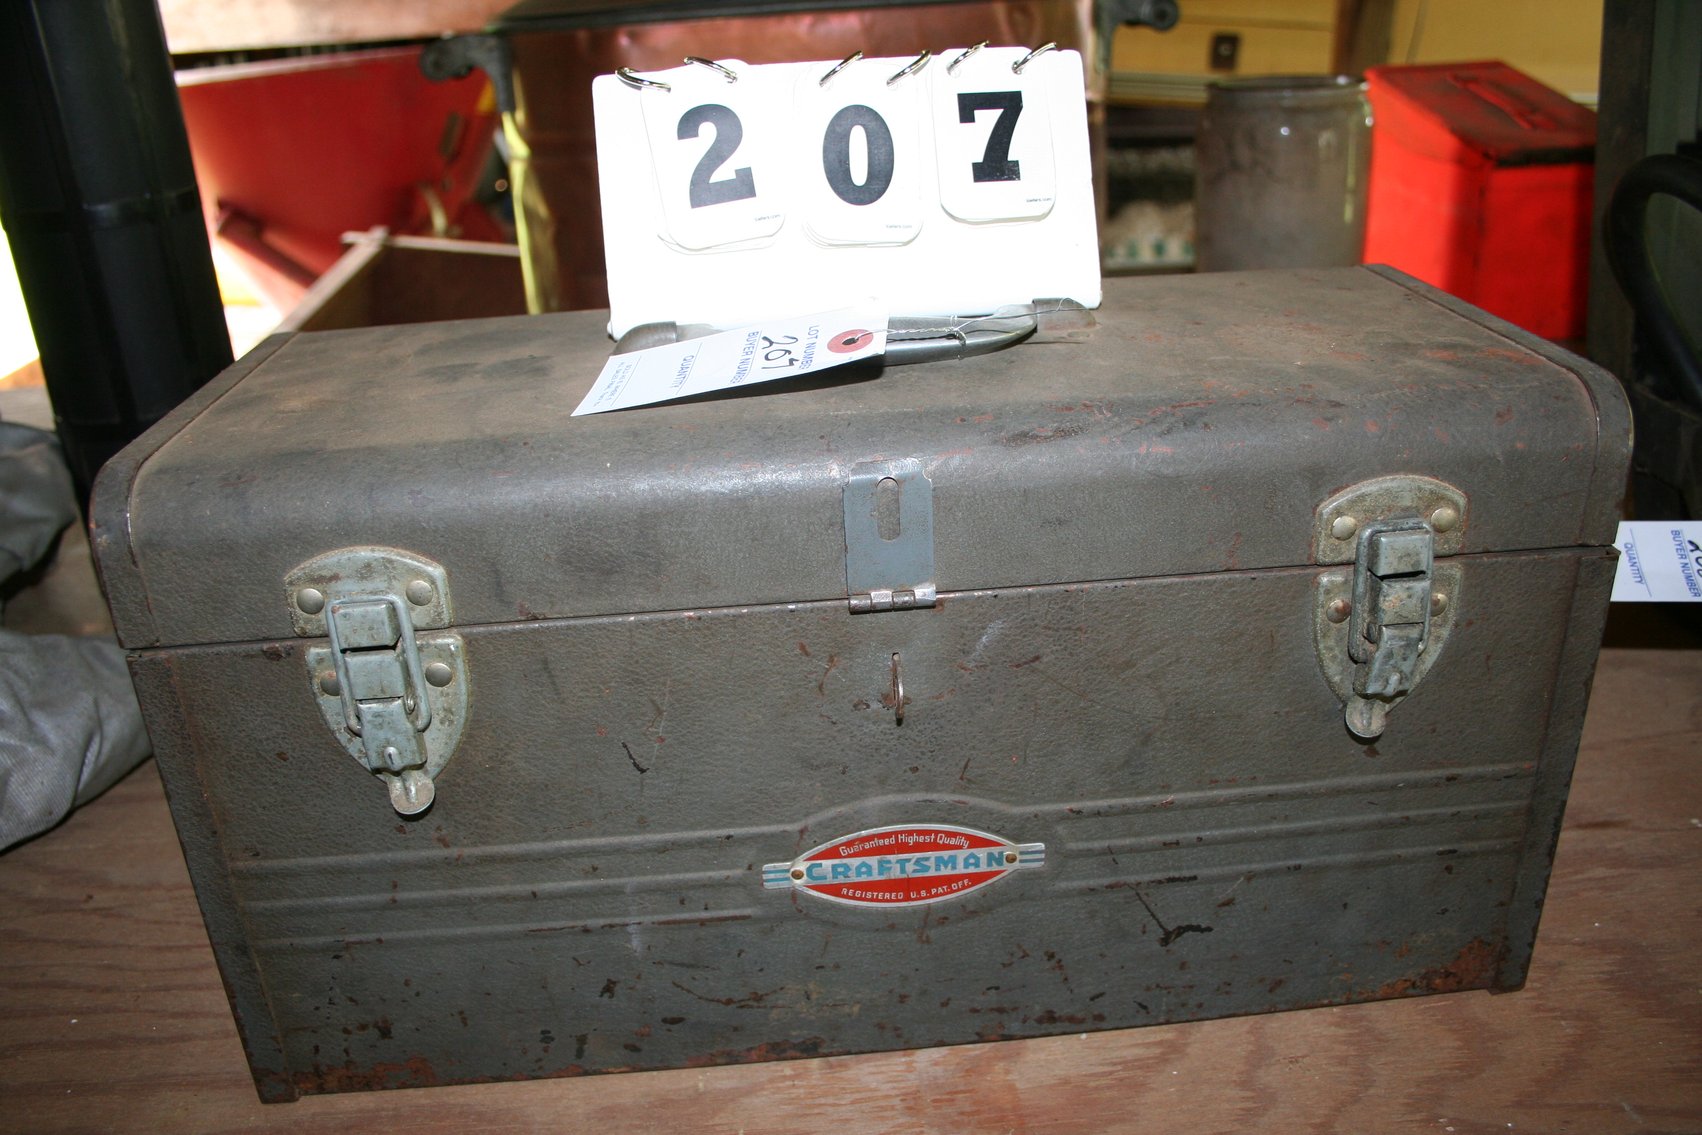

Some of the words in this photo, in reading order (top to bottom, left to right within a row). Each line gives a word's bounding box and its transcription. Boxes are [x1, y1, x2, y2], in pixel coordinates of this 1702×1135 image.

[677, 103, 757, 209] 2
[822, 104, 895, 206] 0
[957, 90, 1024, 183] 7
[742, 331, 759, 357] BUYER
[806, 325, 820, 340] LOT
[1623, 542, 1645, 585] QUANTITY
[1670, 529, 1687, 560] BUYER
[1680, 561, 1701, 598] NUMBER
[839, 835, 896, 857] Guaranteed
[898, 833, 935, 846] Highest
[936, 833, 970, 849] Quality
[805, 851, 1005, 882] CRAFTSMAN
[841, 887, 904, 900] REGISTERED
[910, 889, 930, 899] U.S.
[931, 886, 951, 896] PAT.
[951, 878, 972, 890] OFF.
